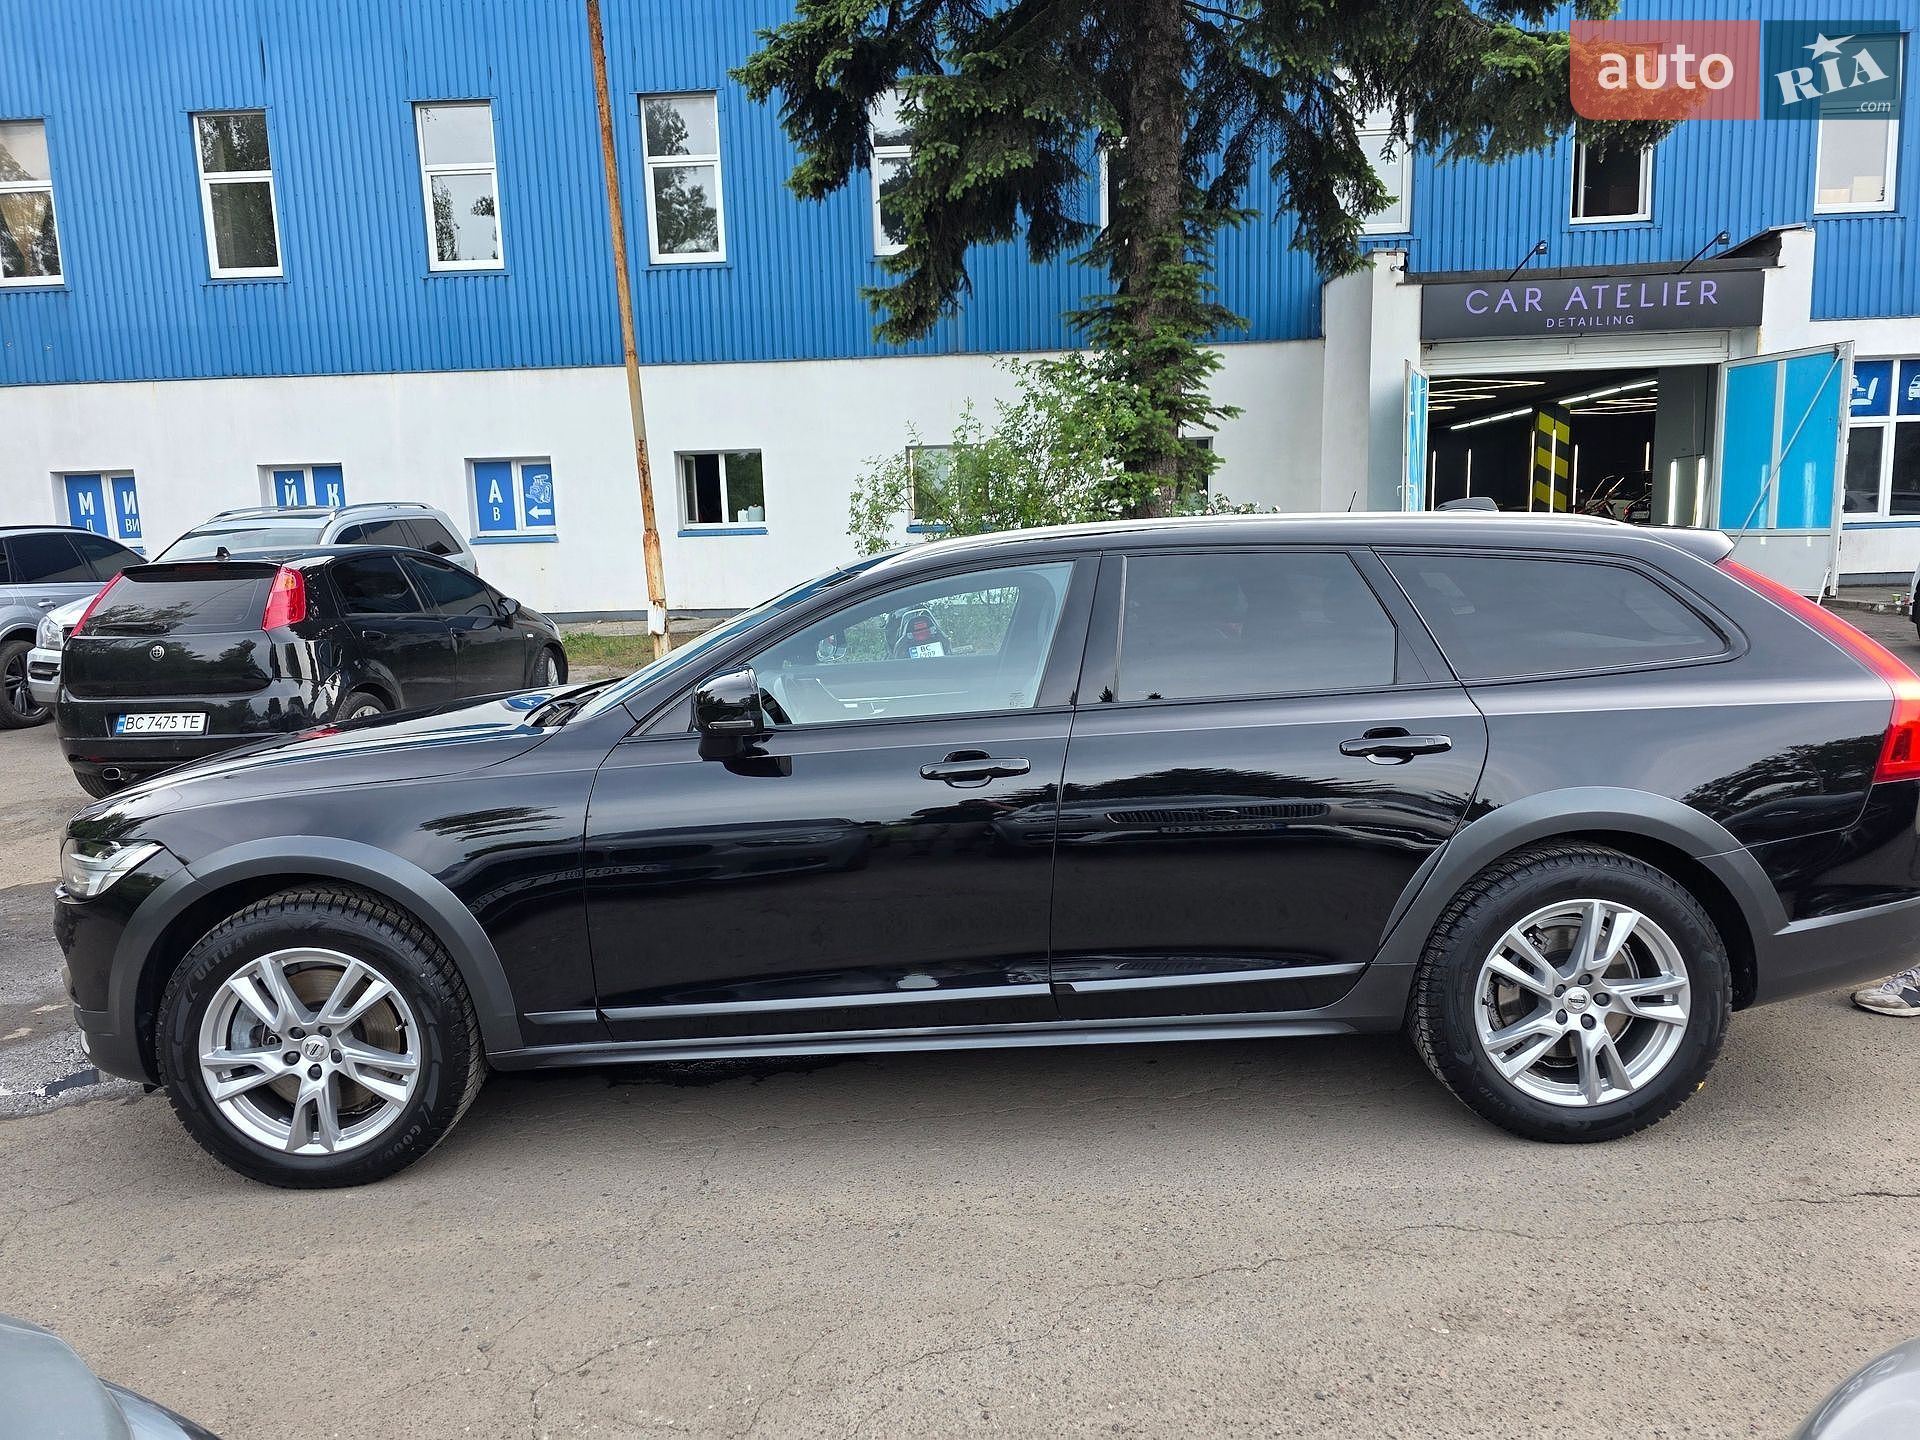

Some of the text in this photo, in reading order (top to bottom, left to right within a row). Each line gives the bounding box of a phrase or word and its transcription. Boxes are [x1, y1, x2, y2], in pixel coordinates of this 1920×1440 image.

[1465, 280, 1718, 315] CAR ATELIER
[1546, 315, 1635, 328] DETAILING
[125, 715, 201, 730] BC 7475 TE
